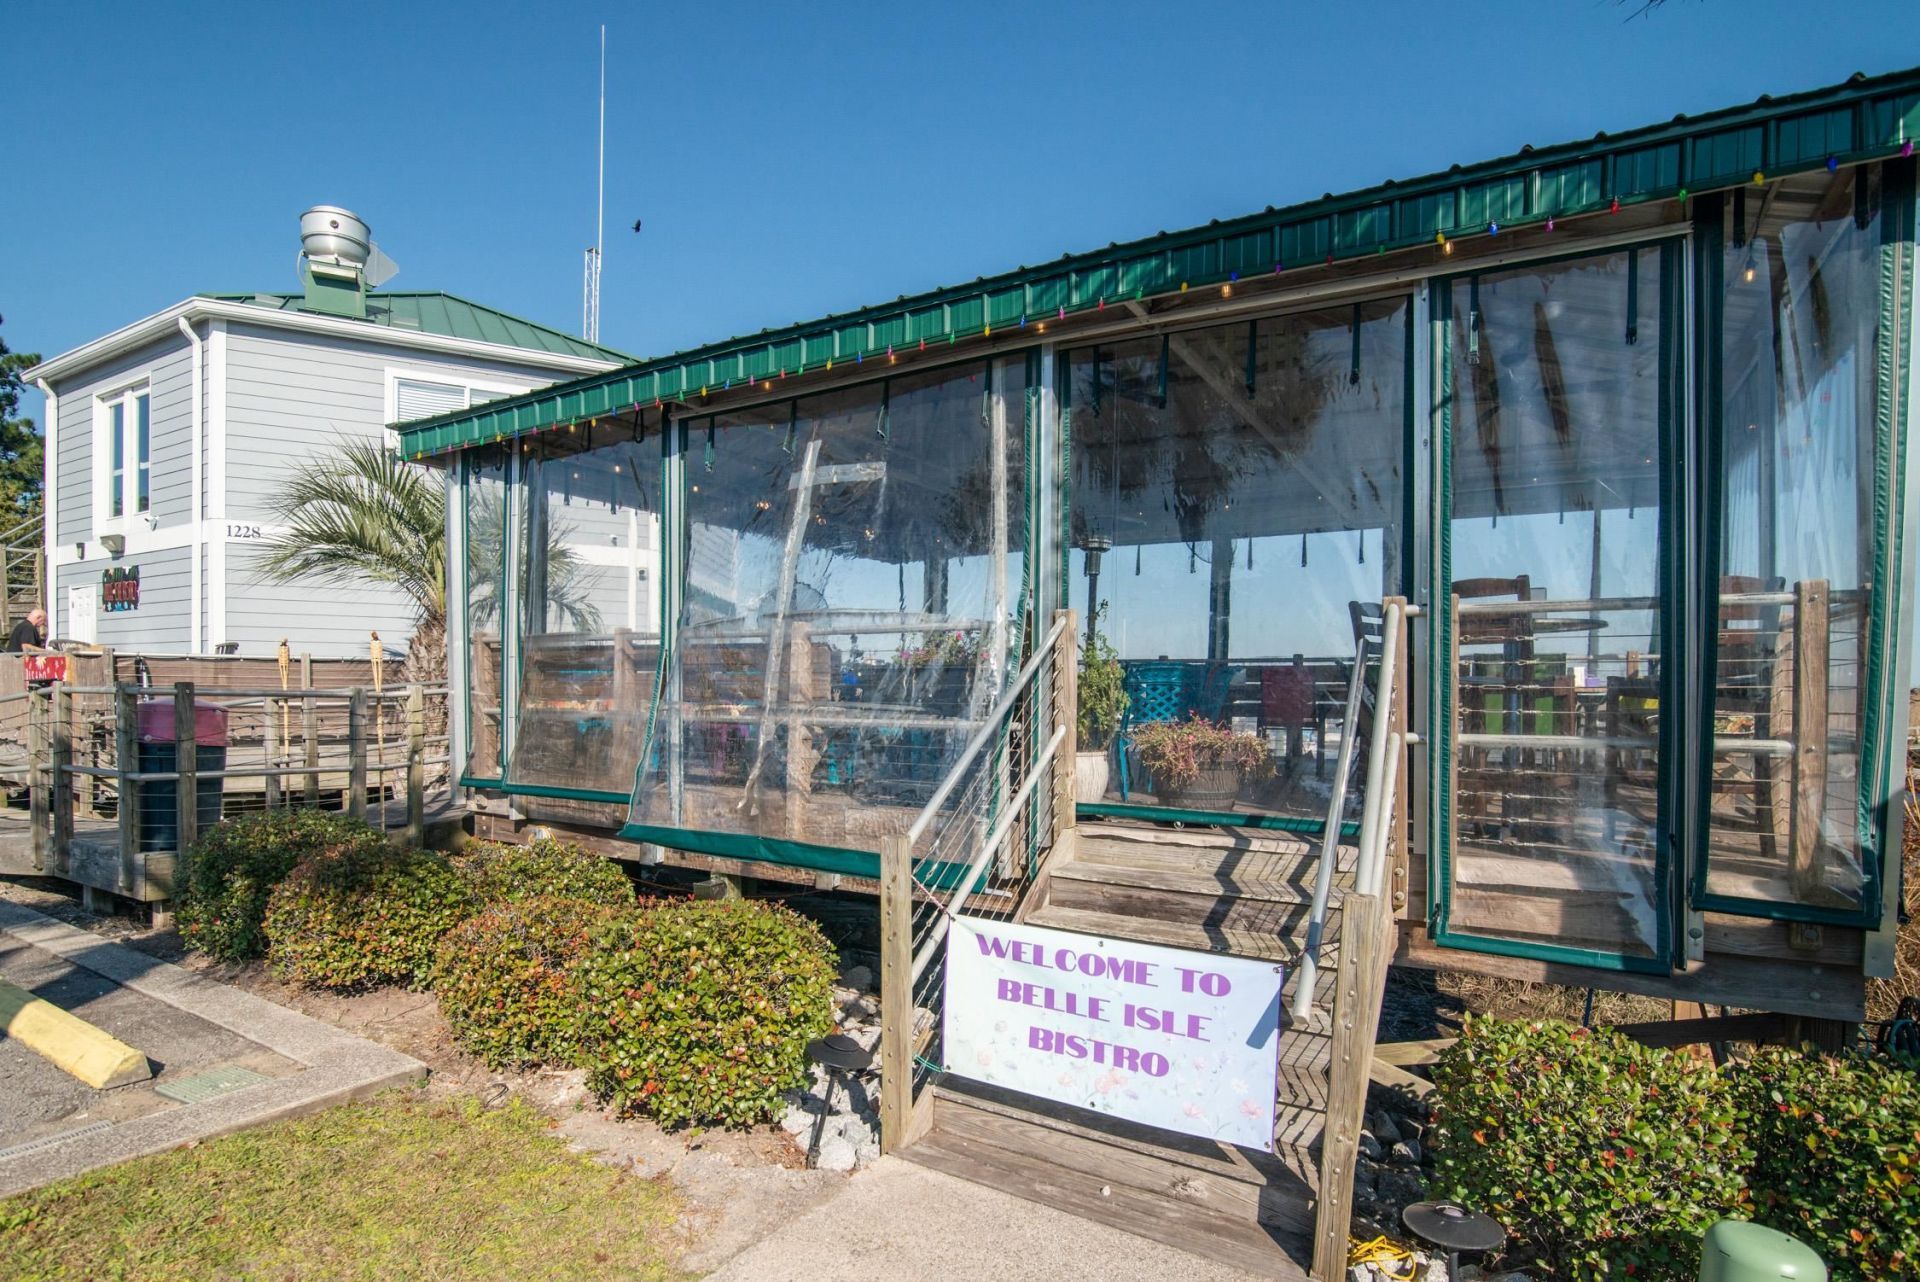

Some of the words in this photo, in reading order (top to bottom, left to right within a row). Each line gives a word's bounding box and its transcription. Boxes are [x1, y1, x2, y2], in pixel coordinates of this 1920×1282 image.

[226, 525, 261, 538] 1228
[975, 933, 1159, 988] WELCOME
[1174, 967, 1232, 998] TO
[997, 978, 1111, 1023] BELLE
[1123, 1003, 1213, 1043] ISLE
[1028, 1026, 1170, 1077] BISTRO
